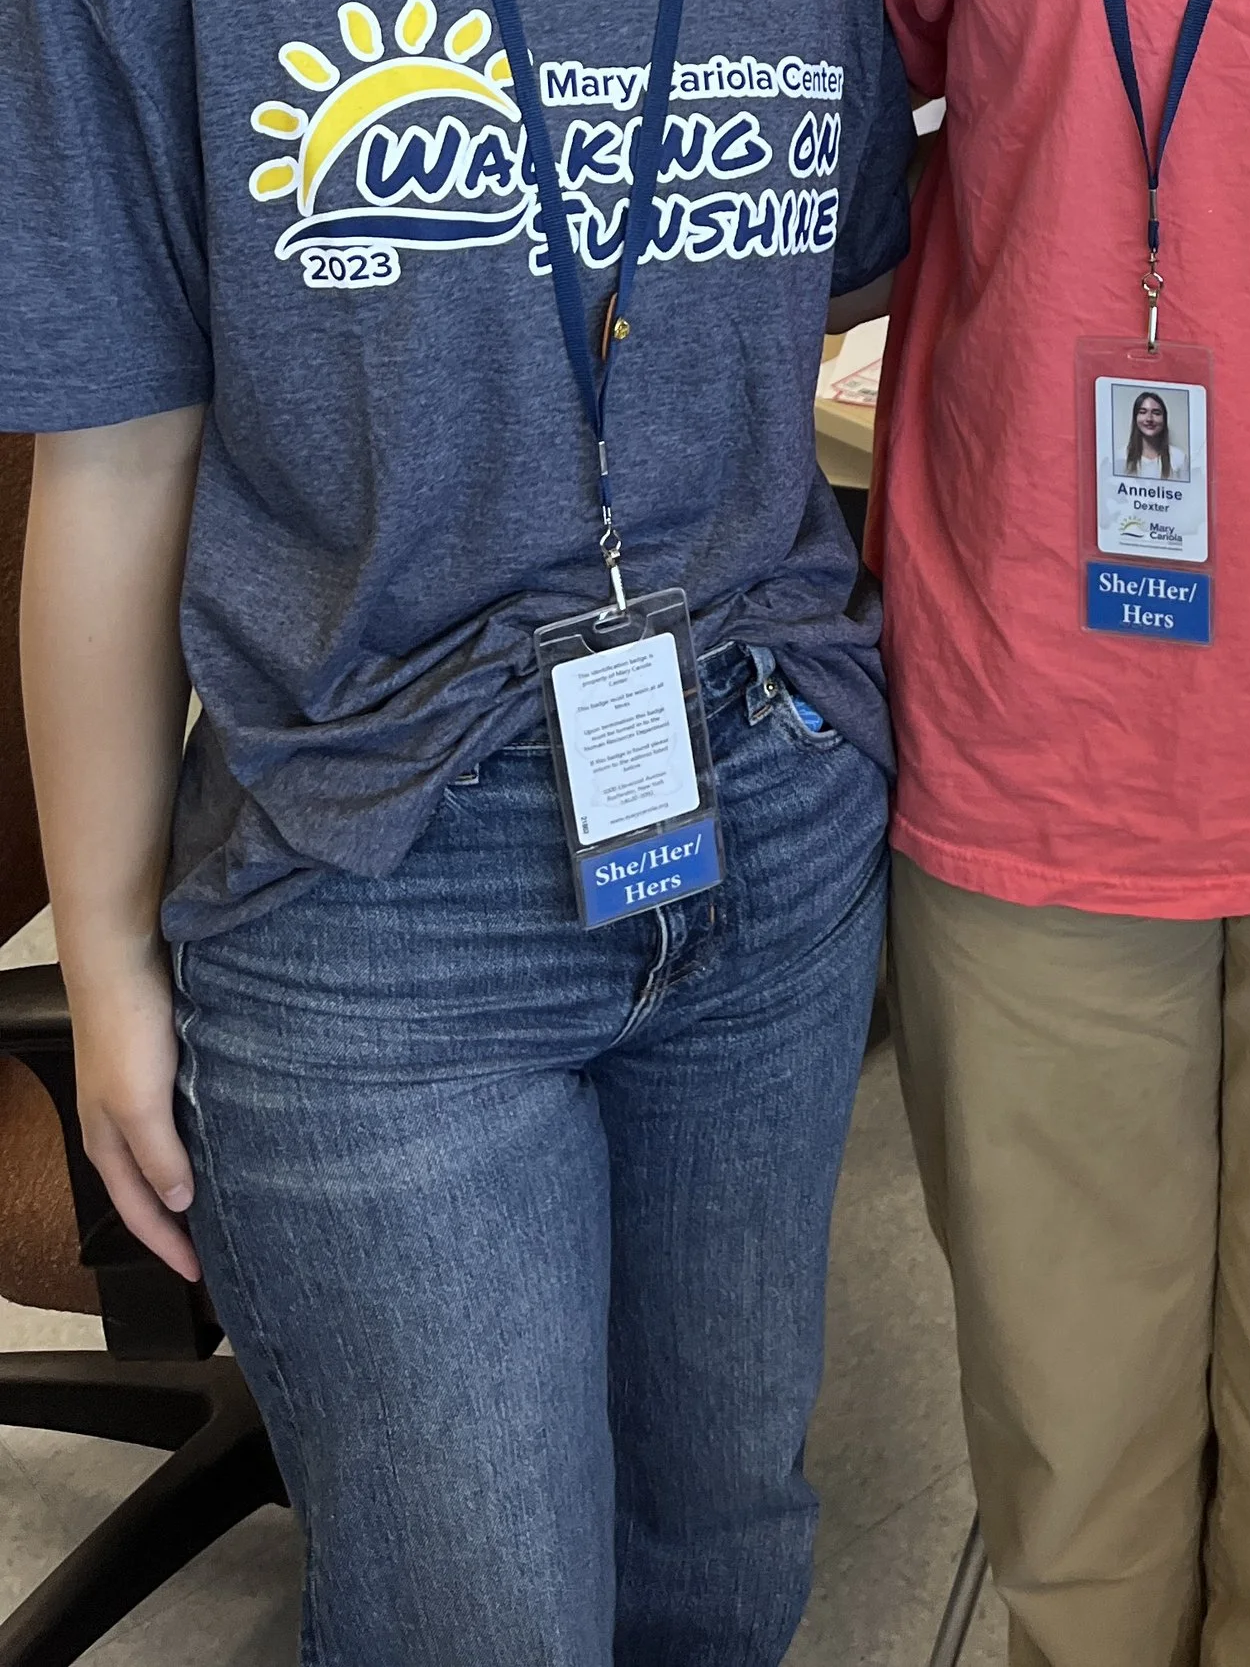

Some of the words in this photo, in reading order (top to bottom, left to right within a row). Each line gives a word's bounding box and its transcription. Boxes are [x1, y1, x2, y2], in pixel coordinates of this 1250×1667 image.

[546, 68, 638, 103] Mary
[670, 61, 774, 93] ariola
[782, 61, 842, 94] Center
[793, 118, 838, 173] ON
[311, 254, 393, 282] 2023
[1117, 482, 1183, 500] Annelise
[1133, 500, 1170, 512] Dexter
[1149, 523, 1175, 534] Mary
[1099, 572, 1198, 602] She/Her/
[1122, 603, 1175, 629] Hers
[595, 833, 702, 886] She/Her/
[624, 873, 682, 905] Hers
